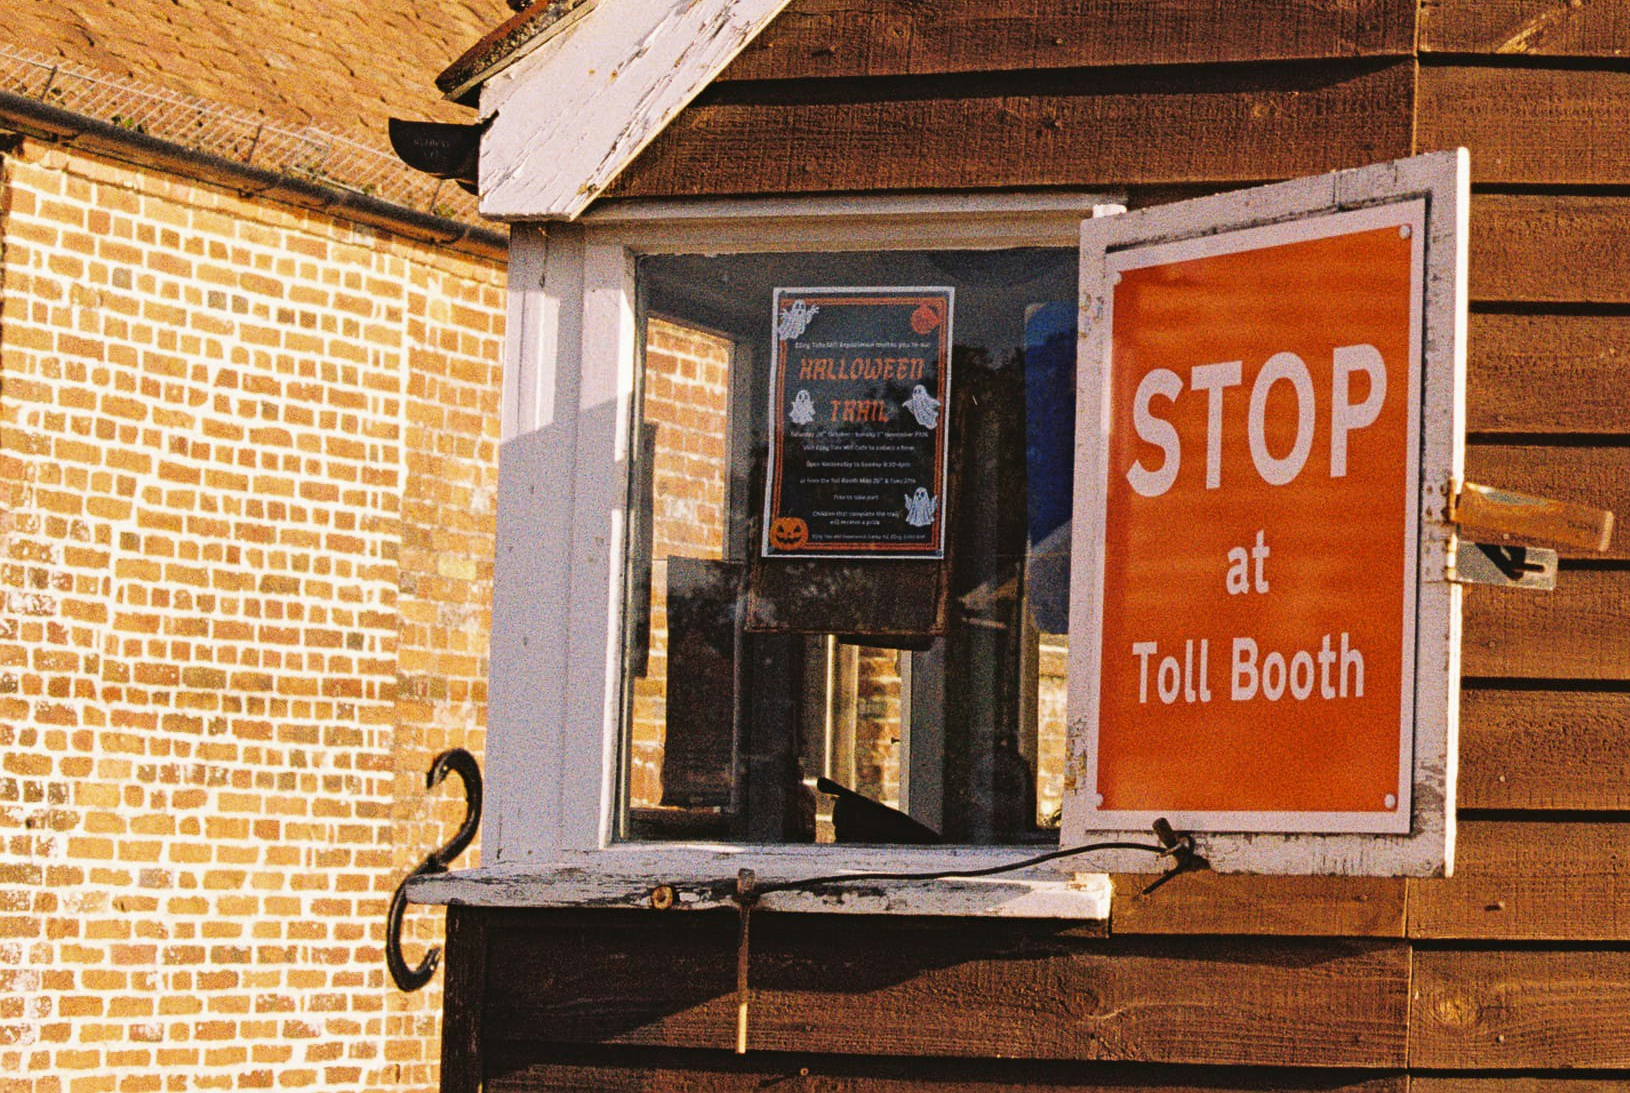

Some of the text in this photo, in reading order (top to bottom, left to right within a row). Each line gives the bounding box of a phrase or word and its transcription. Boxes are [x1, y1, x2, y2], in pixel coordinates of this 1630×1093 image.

[799, 357, 924, 381] HALLOWEEN
[830, 399, 890, 423] TRAIL
[1126, 343, 1388, 497] STOP
[1225, 529, 1270, 596] at
[1131, 632, 1365, 705] Toll Booth
